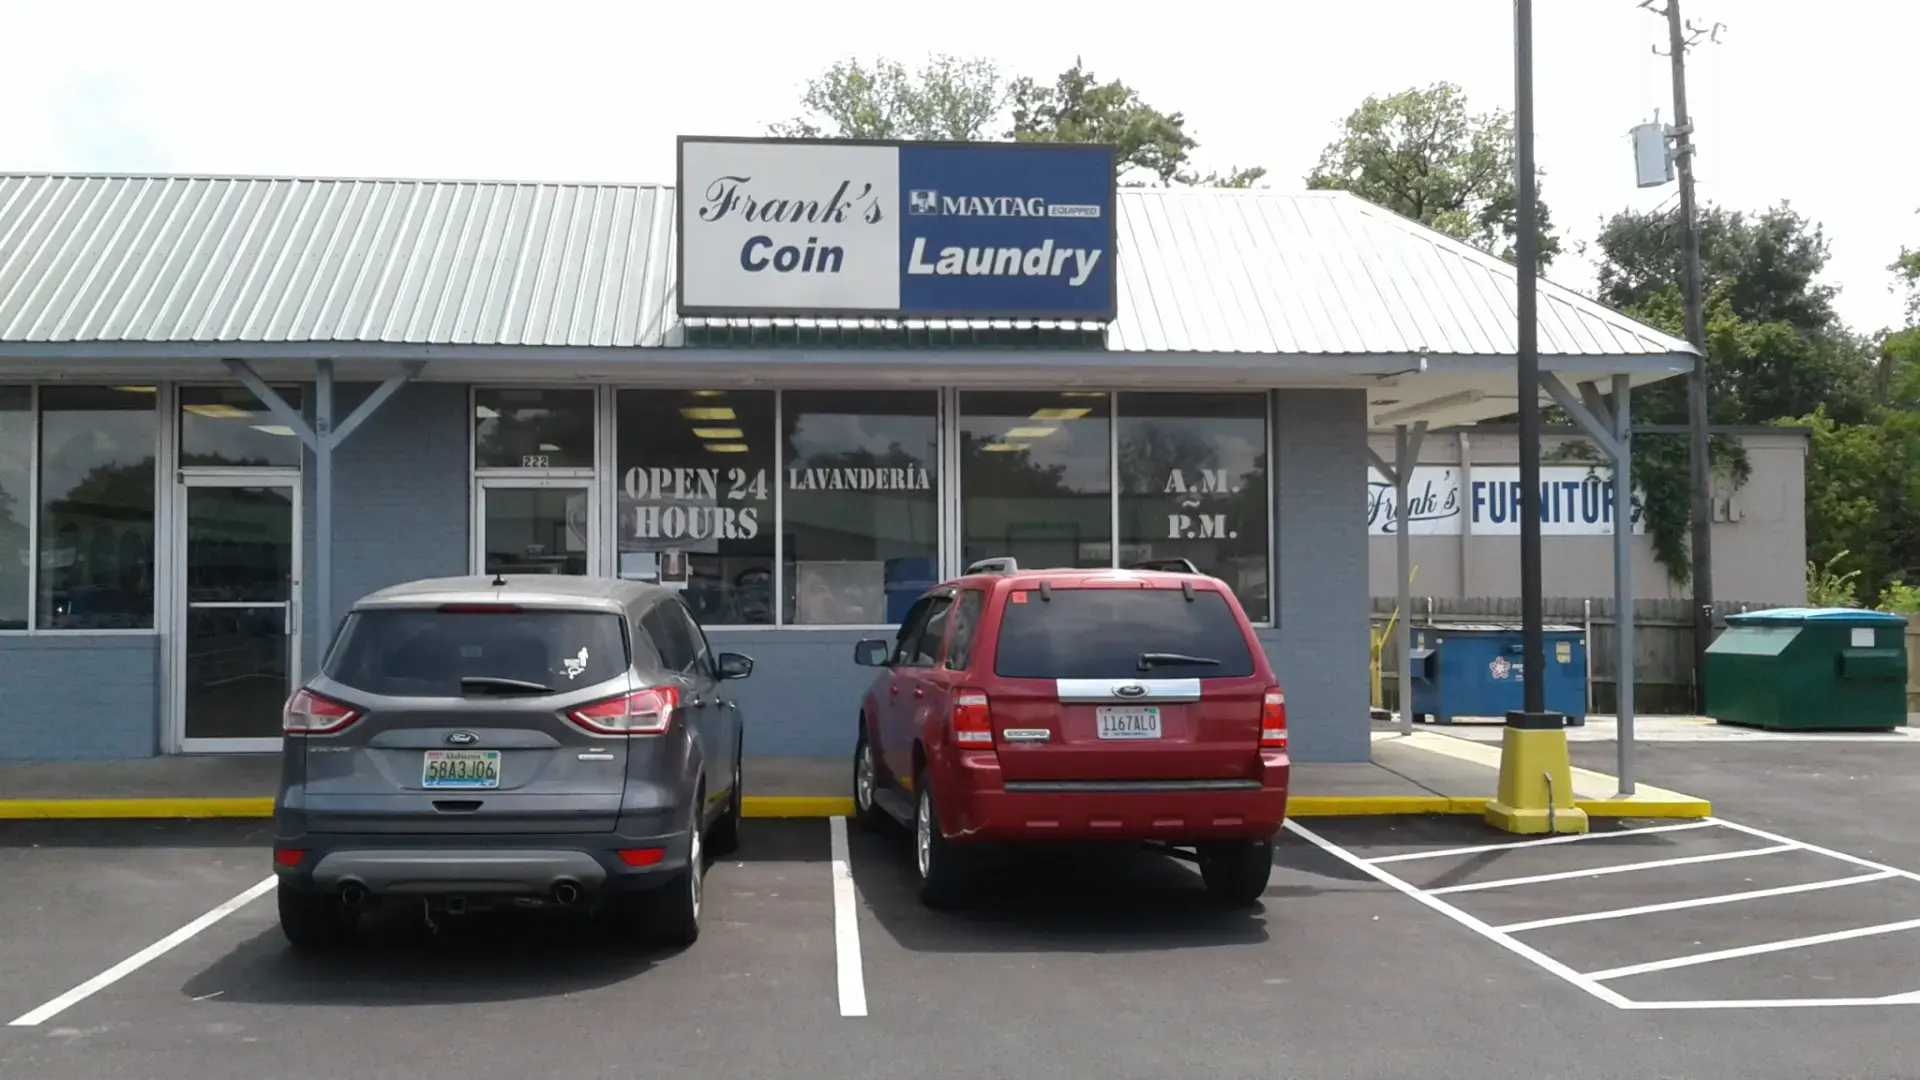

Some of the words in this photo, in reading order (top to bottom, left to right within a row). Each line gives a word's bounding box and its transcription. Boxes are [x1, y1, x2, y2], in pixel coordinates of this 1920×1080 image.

[699, 176, 883, 224] Frank's
[942, 196, 1045, 217] MAYTAG
[1051, 206, 1097, 215] EQUIPPED
[740, 235, 844, 273] Coin
[907, 237, 1102, 286] Laundry
[523, 455, 548, 468] 222
[789, 462, 930, 490] LAVANDERÍA
[625, 467, 719, 499] OPEN
[728, 468, 768, 500] 24
[1163, 469, 1240, 493] A.M.
[1368, 470, 1460, 533] Frnk's
[635, 506, 758, 539] HOURS
[1168, 514, 1237, 539] P.M.
[429, 761, 494, 778] 58A3J06
